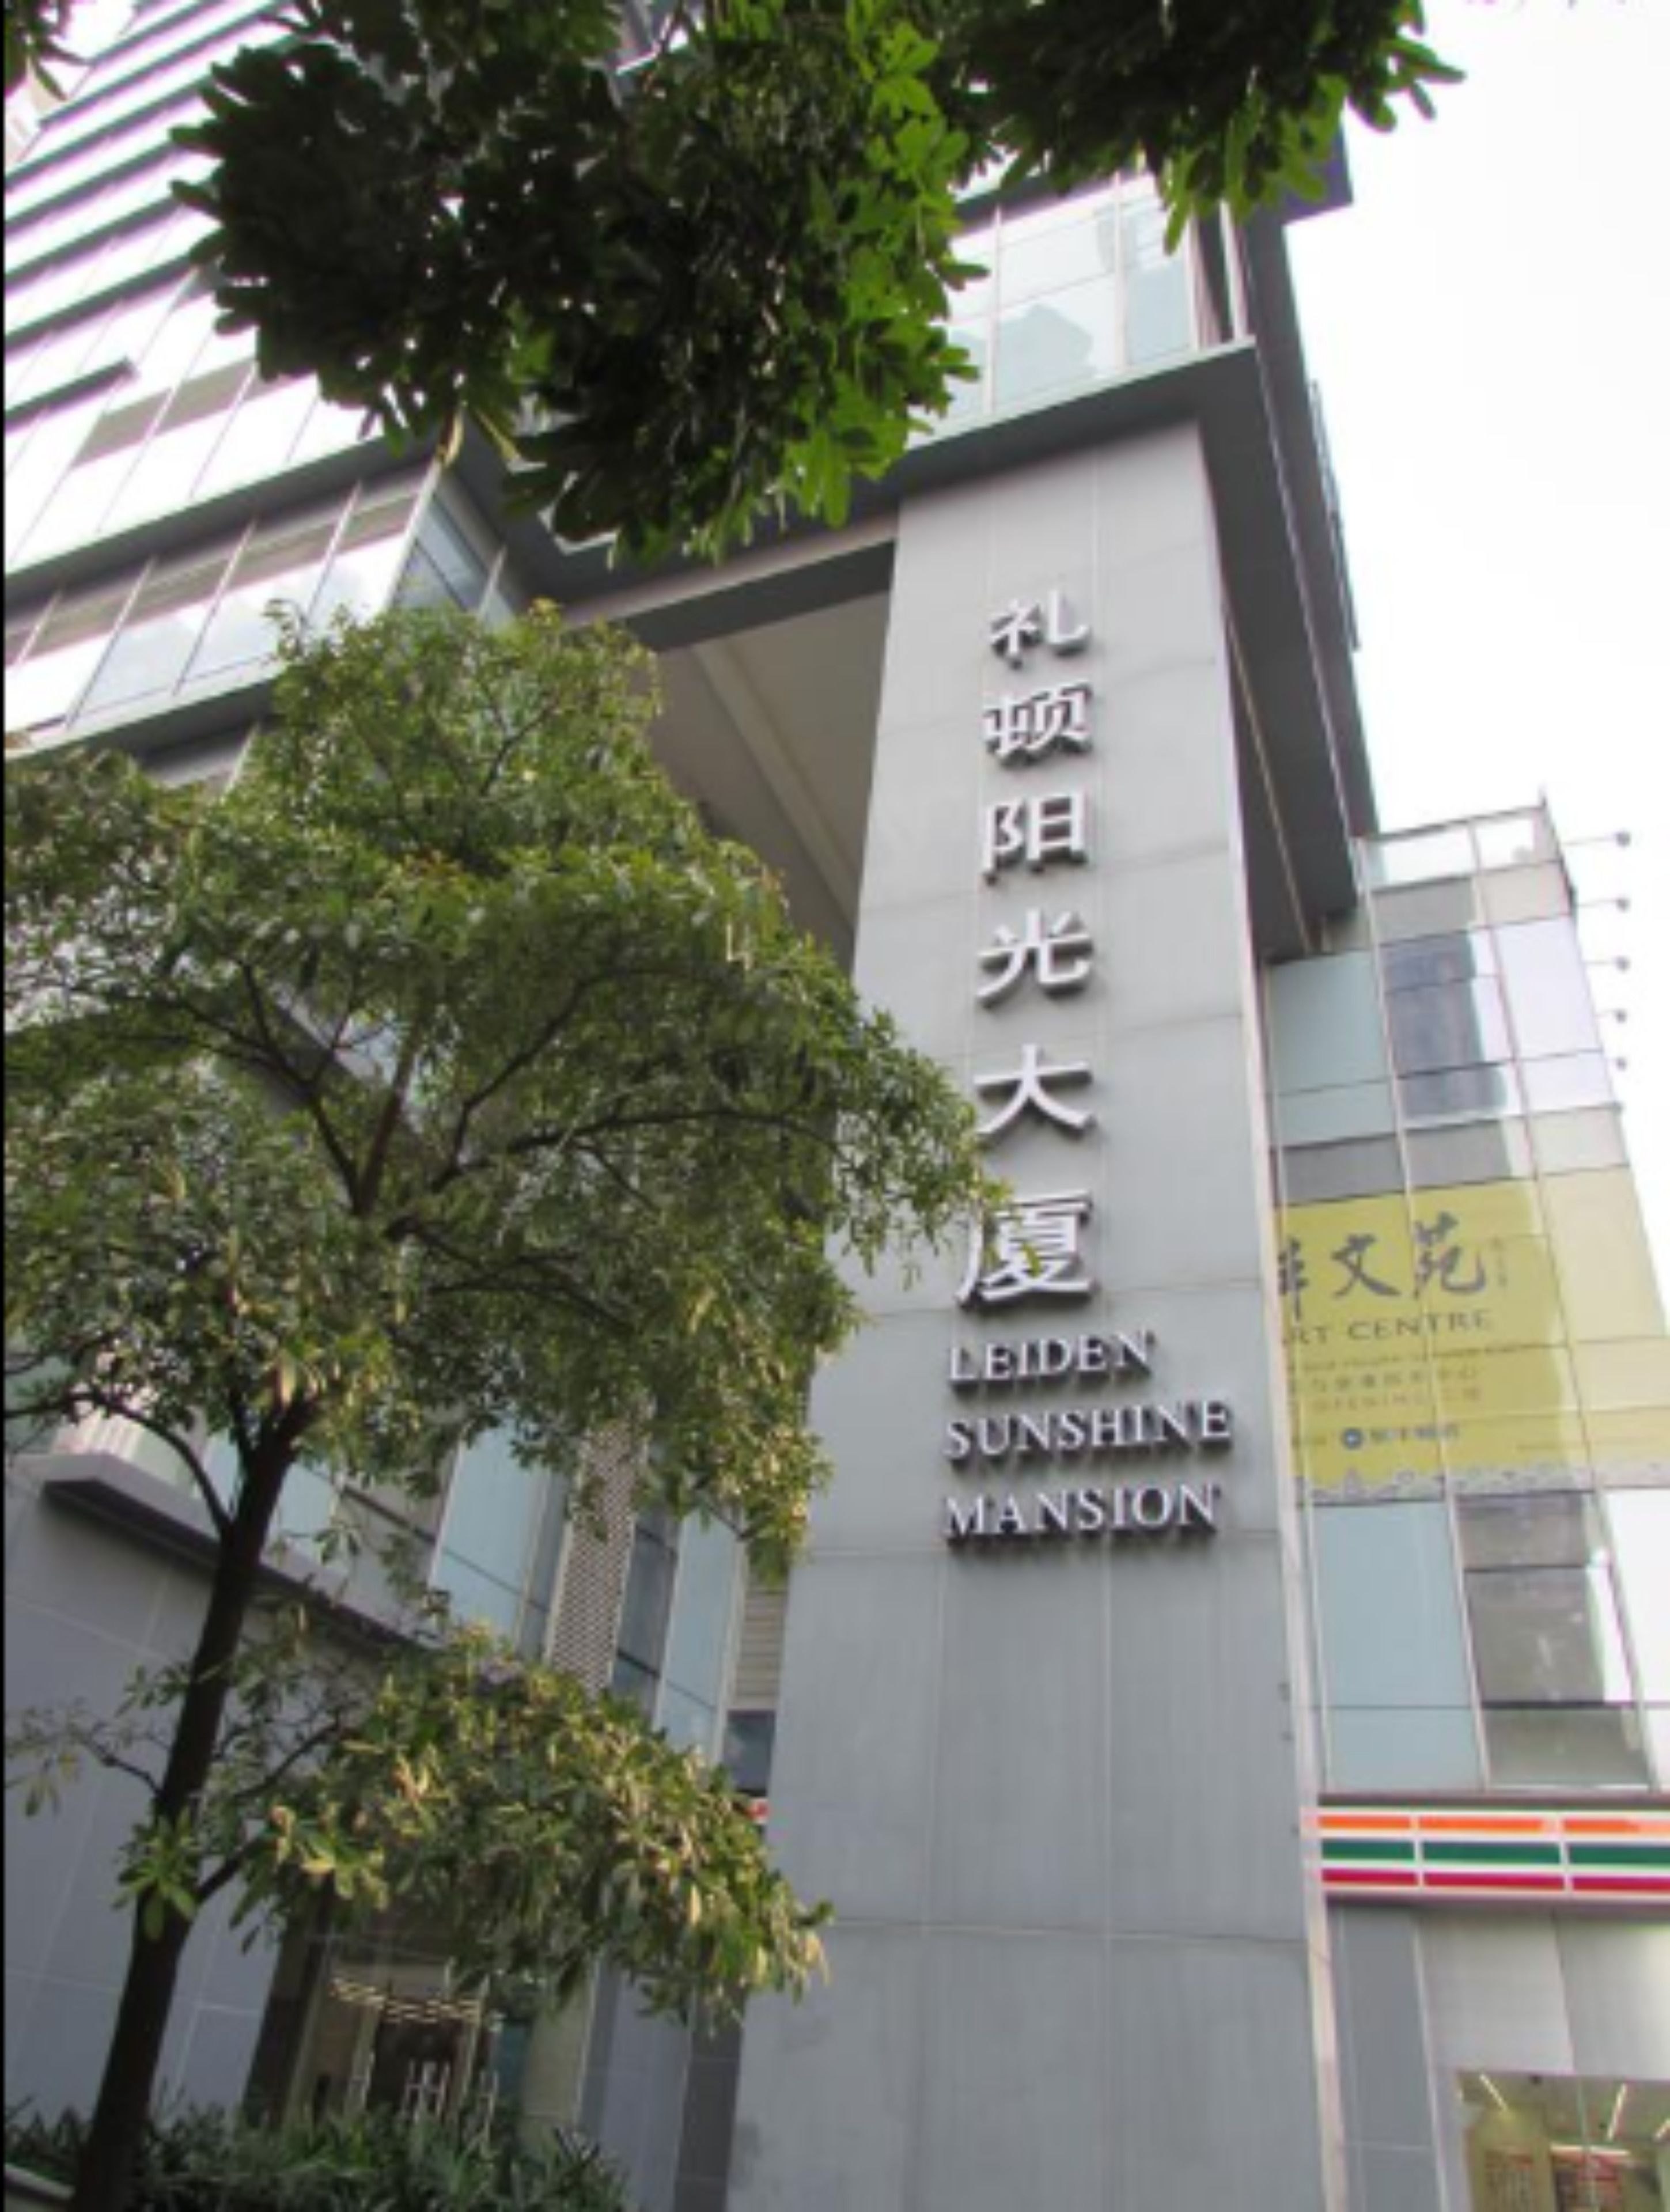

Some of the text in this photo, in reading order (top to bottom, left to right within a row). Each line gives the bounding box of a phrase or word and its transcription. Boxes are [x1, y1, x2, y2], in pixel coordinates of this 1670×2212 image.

[957, 589, 1095, 1310] 礼顿阳光大厦
[1347, 1309, 1491, 1340] CENTRE
[948, 1329, 1154, 1387] LEIDEN
[944, 1399, 1232, 1466] SUNSHINE
[945, 1482, 1220, 1546] MANSION
